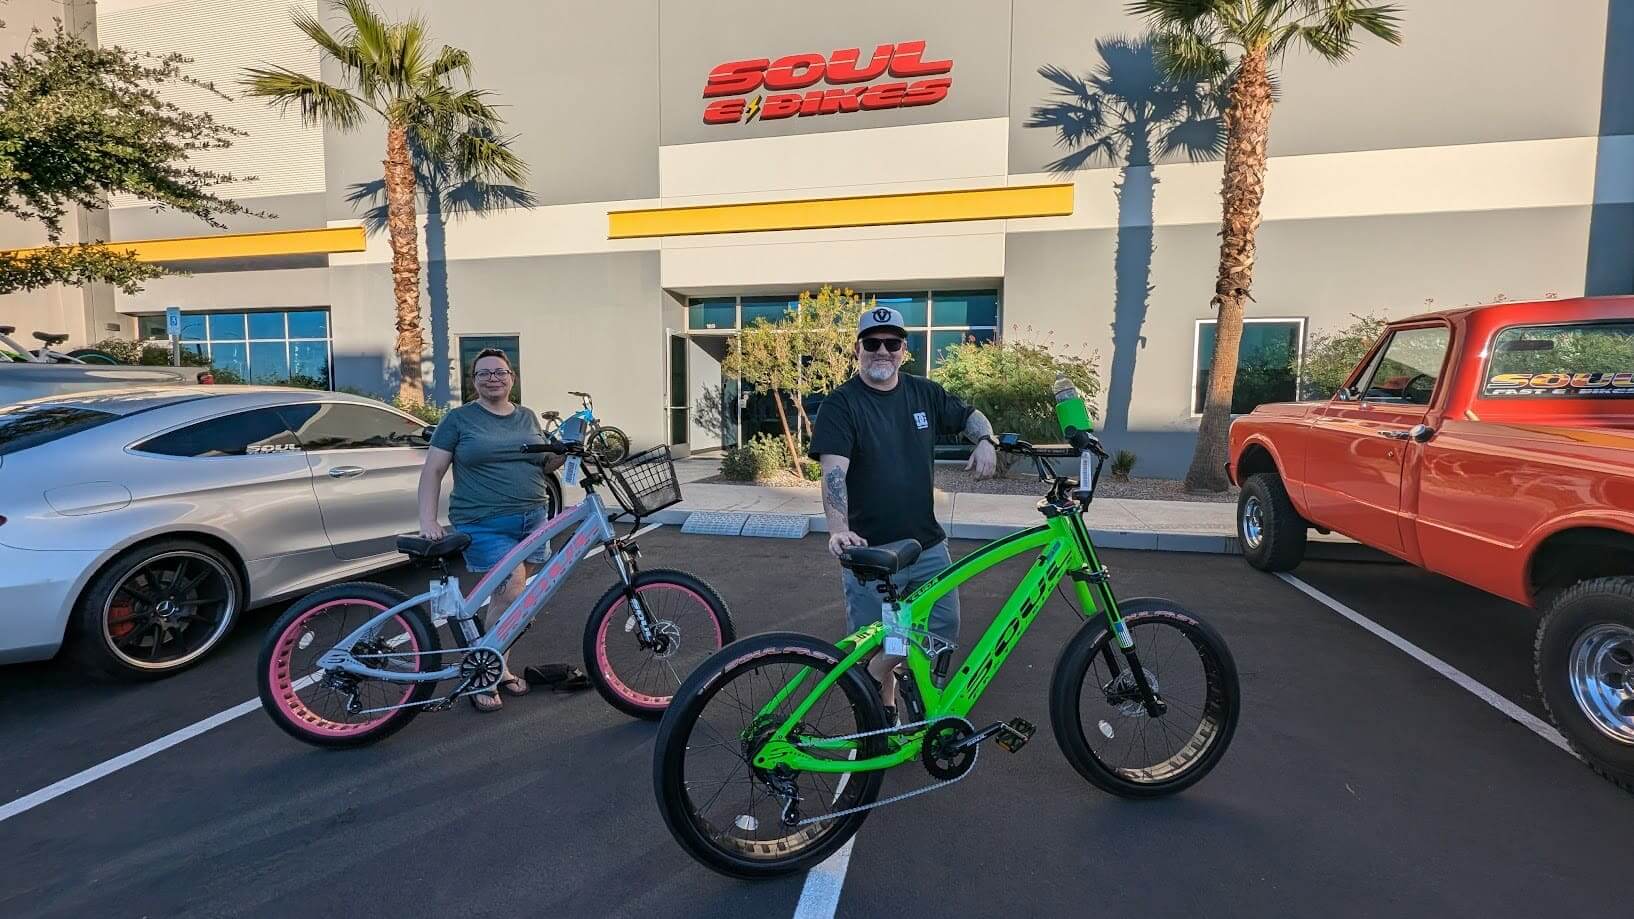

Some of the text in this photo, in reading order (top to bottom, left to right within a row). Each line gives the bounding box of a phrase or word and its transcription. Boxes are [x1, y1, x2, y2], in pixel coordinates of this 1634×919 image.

[703, 40, 953, 98] SOUL
[247, 444, 301, 452] SOUL
[967, 551, 1073, 699] SOUL
